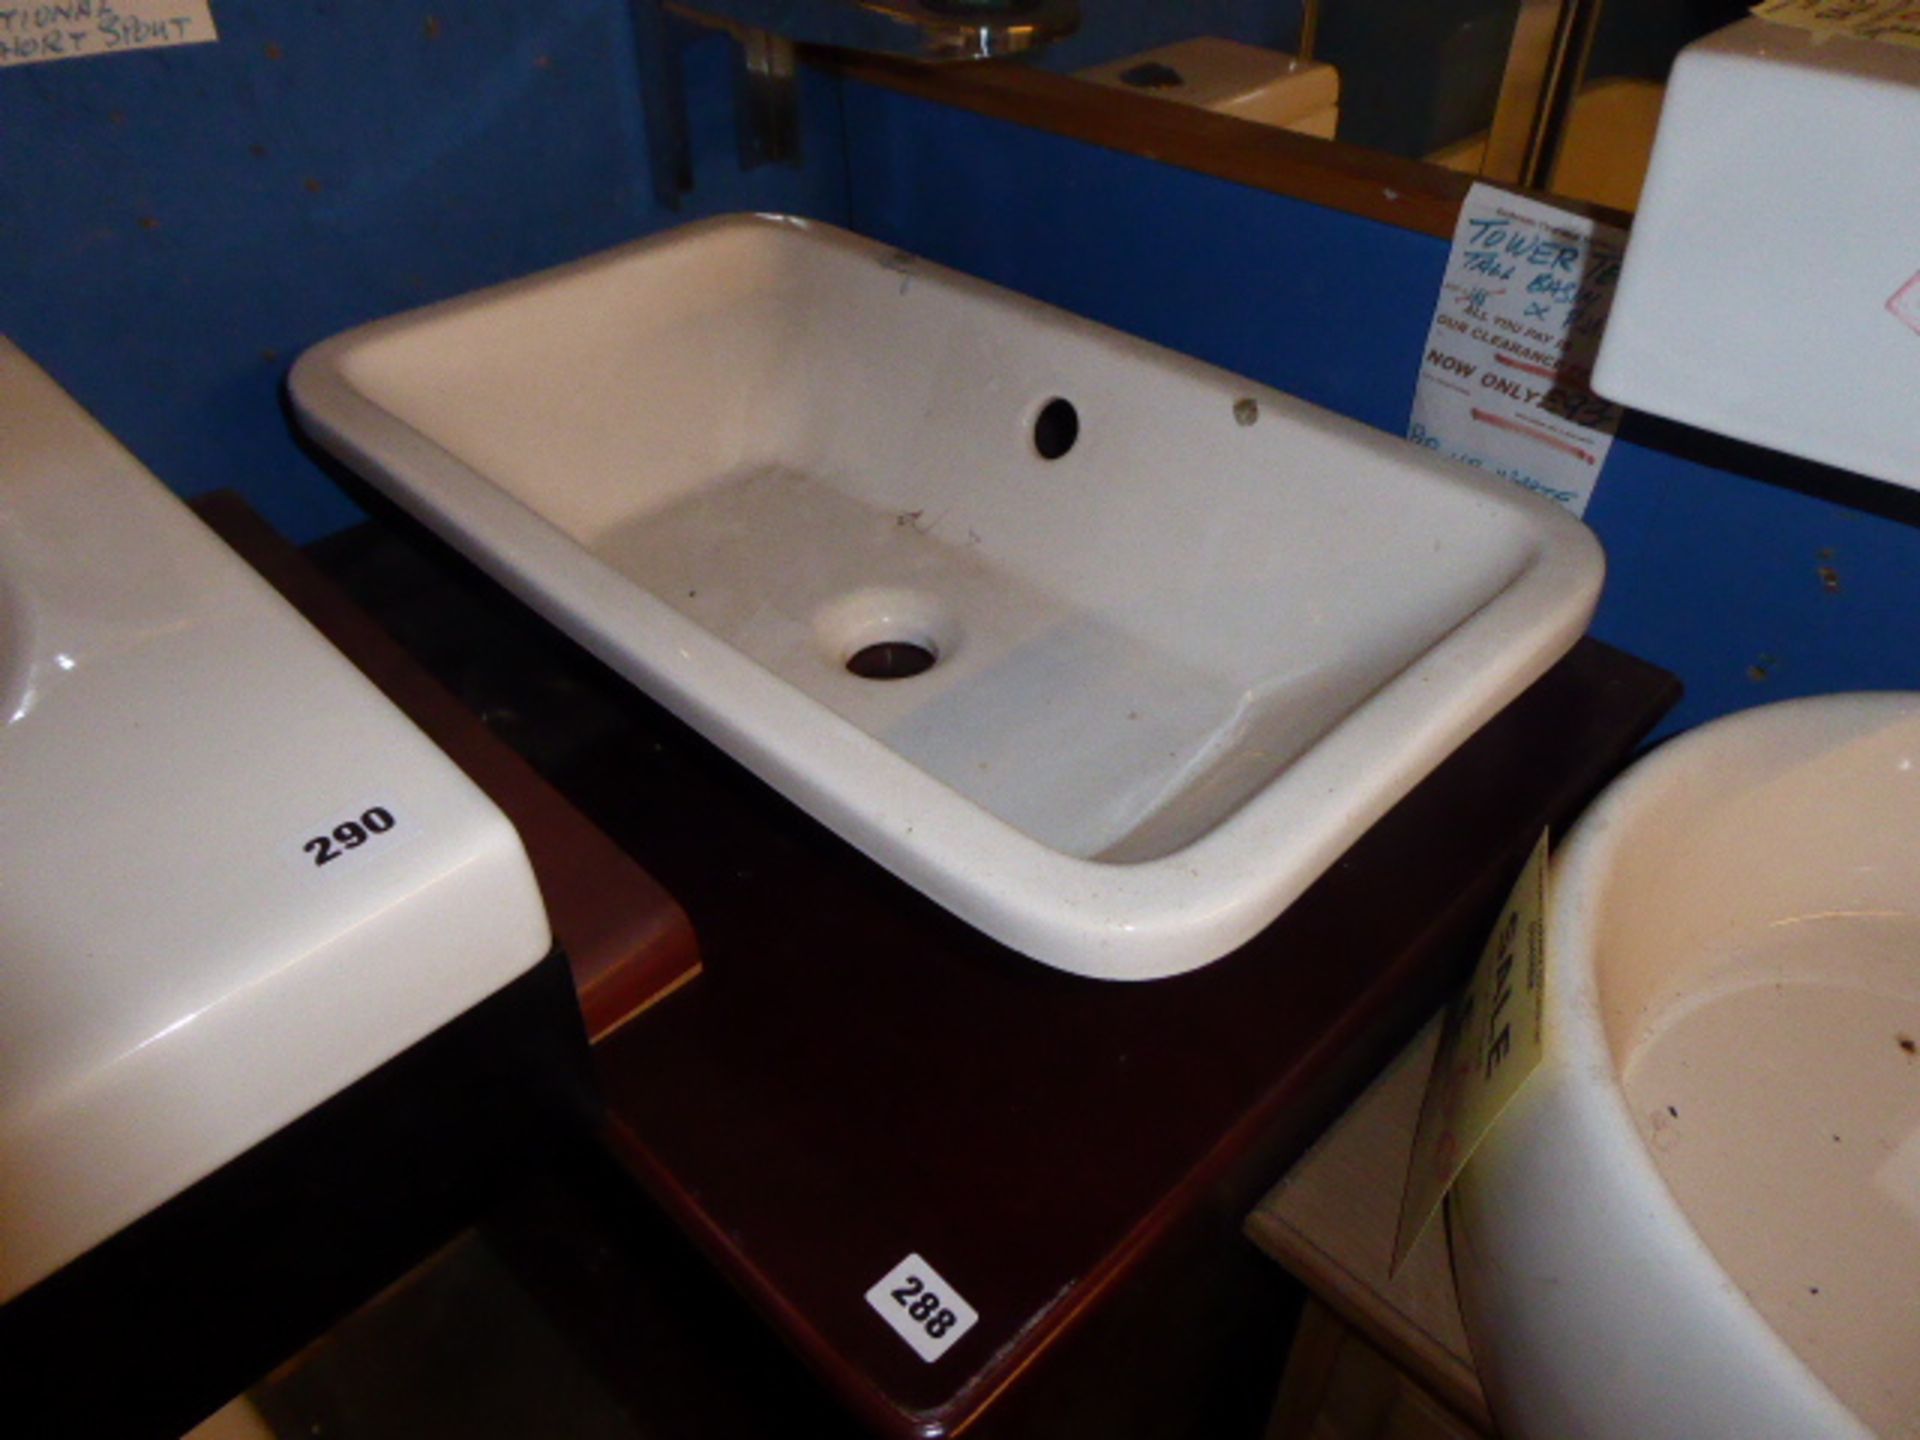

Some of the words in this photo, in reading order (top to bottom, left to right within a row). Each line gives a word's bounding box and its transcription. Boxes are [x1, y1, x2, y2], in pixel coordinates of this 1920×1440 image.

[1463, 250, 1517, 281] TALL
[1469, 216, 1579, 274] TOWER
[1436, 313, 1469, 334] OUR
[1426, 348, 1478, 379] NOW
[1481, 371, 1541, 406] ONLY
[303, 806, 396, 868] 290
[889, 1274, 958, 1339] 288
